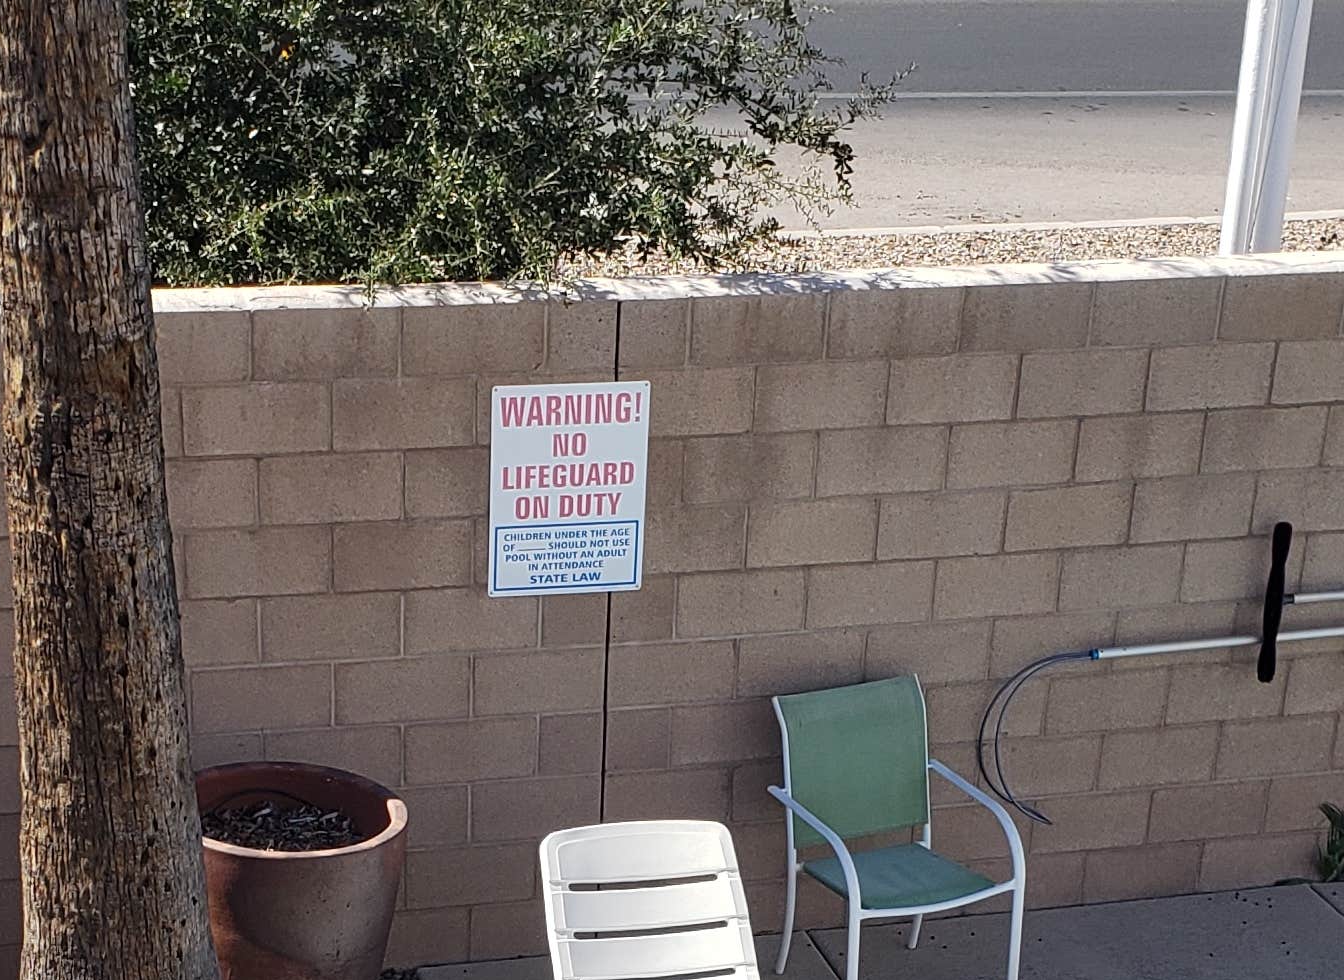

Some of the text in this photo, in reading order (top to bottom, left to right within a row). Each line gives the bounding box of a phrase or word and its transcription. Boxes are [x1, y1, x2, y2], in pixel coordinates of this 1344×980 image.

[500, 392, 642, 428] WARNING!
[552, 433, 587, 457] NO
[502, 461, 635, 490] LIFEGUARD
[515, 492, 622, 520] ON DUTY
[504, 528, 630, 542] CHILDREN UNDER THE AGE
[503, 538, 630, 552] OF SHOULD NOT USE
[505, 549, 627, 562] POOL WITHOUT AN ADULT
[528, 560, 605, 571] IN ATTENDANCE
[530, 572, 601, 584] STATE LAW
